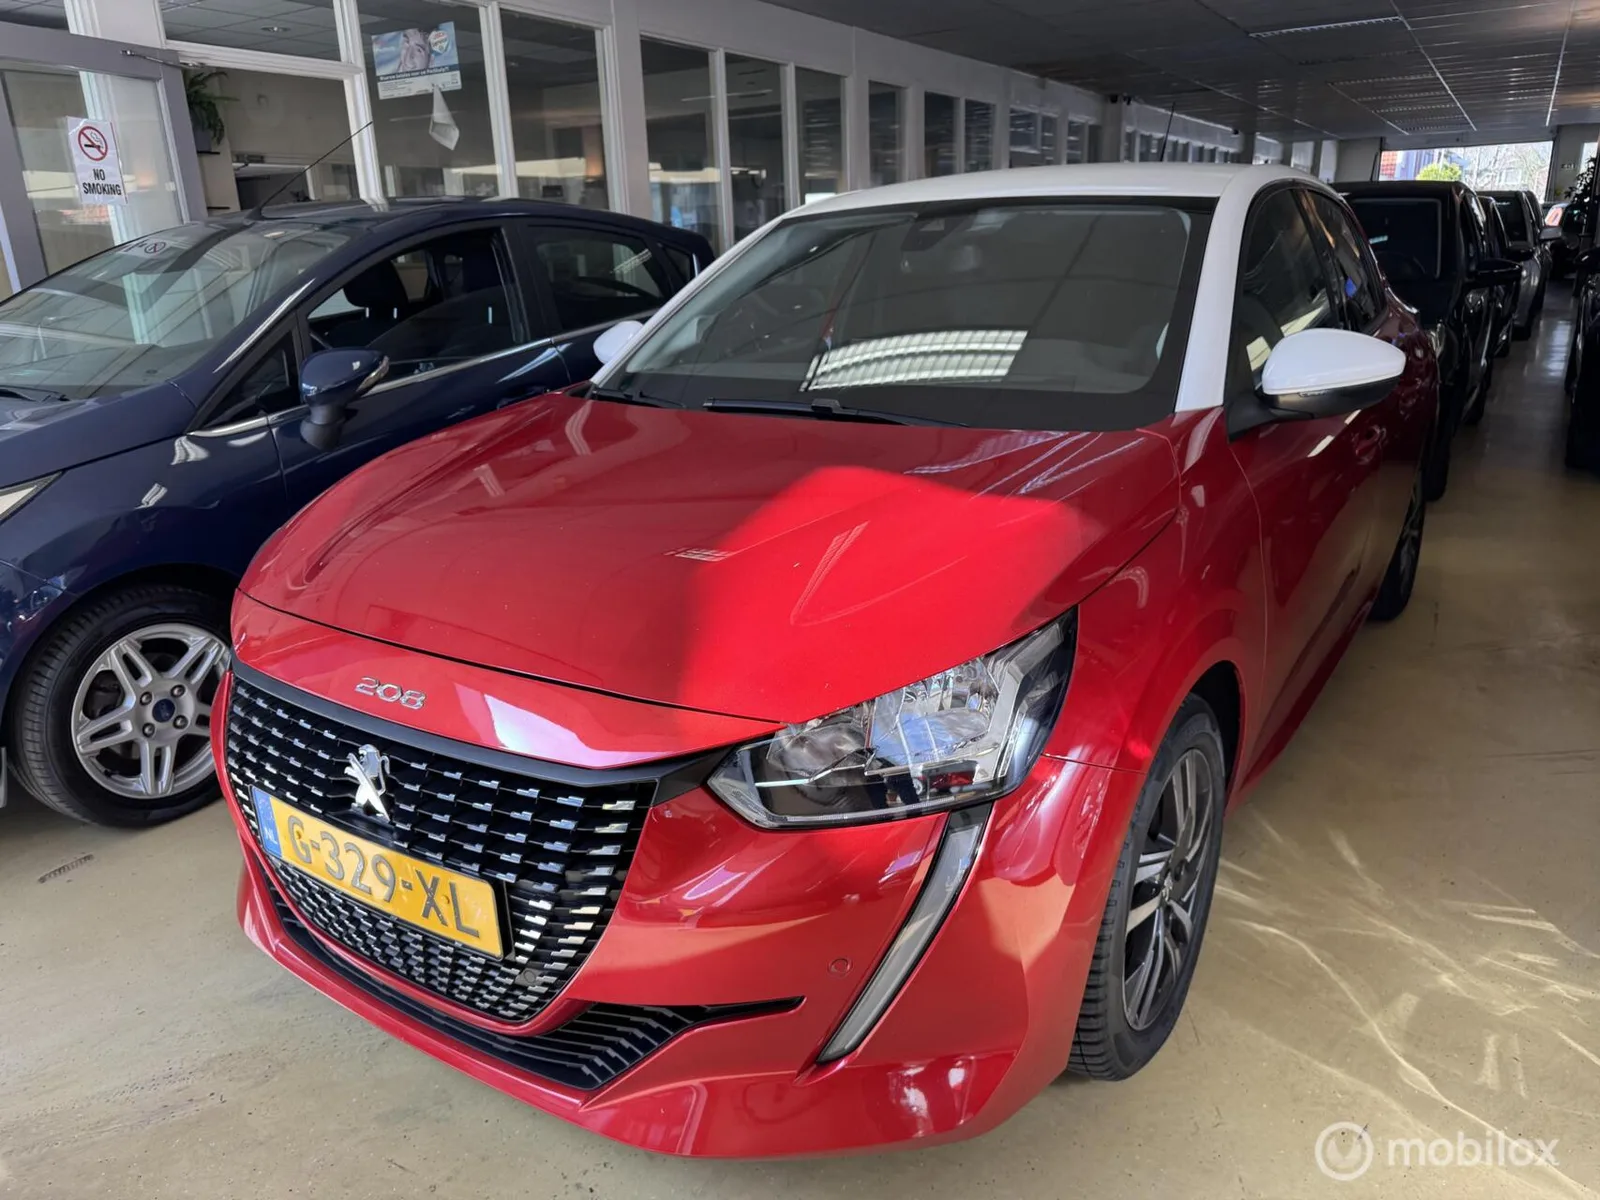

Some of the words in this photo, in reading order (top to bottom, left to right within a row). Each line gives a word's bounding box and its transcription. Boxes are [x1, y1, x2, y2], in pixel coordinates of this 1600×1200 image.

[93, 168, 106, 181] NO
[82, 182, 122, 196] SMOKING
[354, 677, 427, 710] 208
[263, 826, 278, 845] NL
[286, 814, 480, 938] G-329-XL
